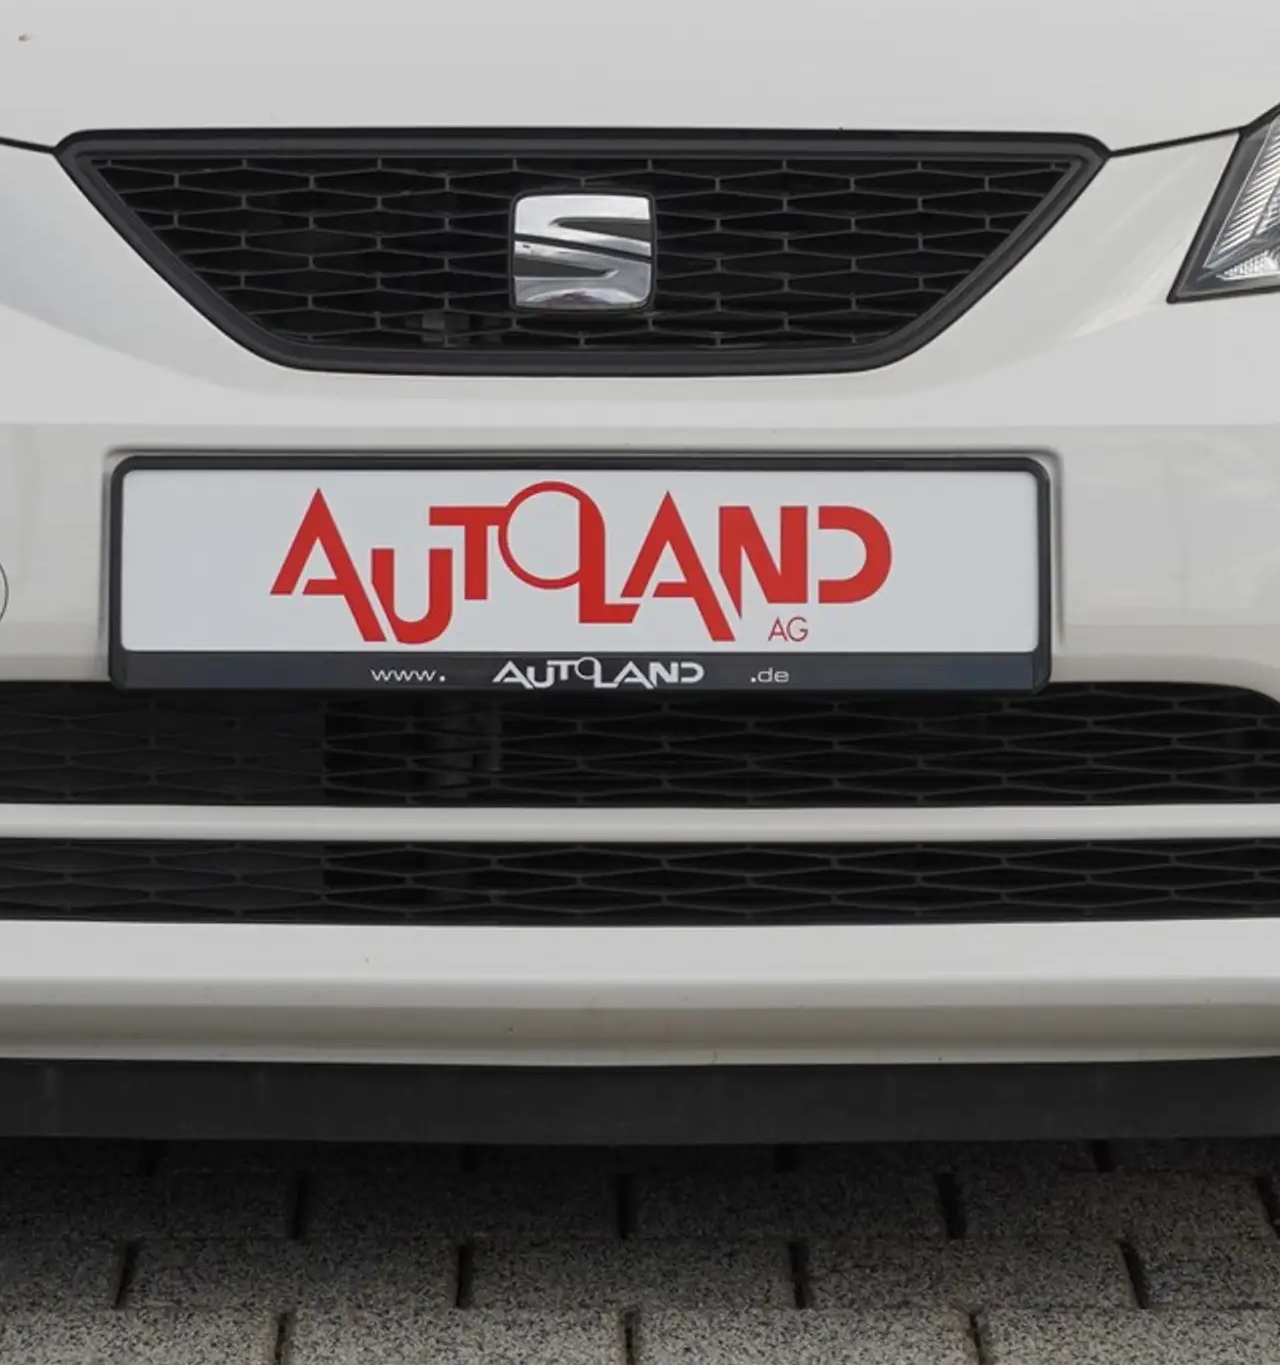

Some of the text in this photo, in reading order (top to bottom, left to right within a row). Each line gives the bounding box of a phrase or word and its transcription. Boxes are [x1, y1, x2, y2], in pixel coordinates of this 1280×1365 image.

[270, 481, 892, 644] AUTOLAND
[768, 616, 809, 642] AG
[370, 656, 790, 690] www. AUTOLAND .de
